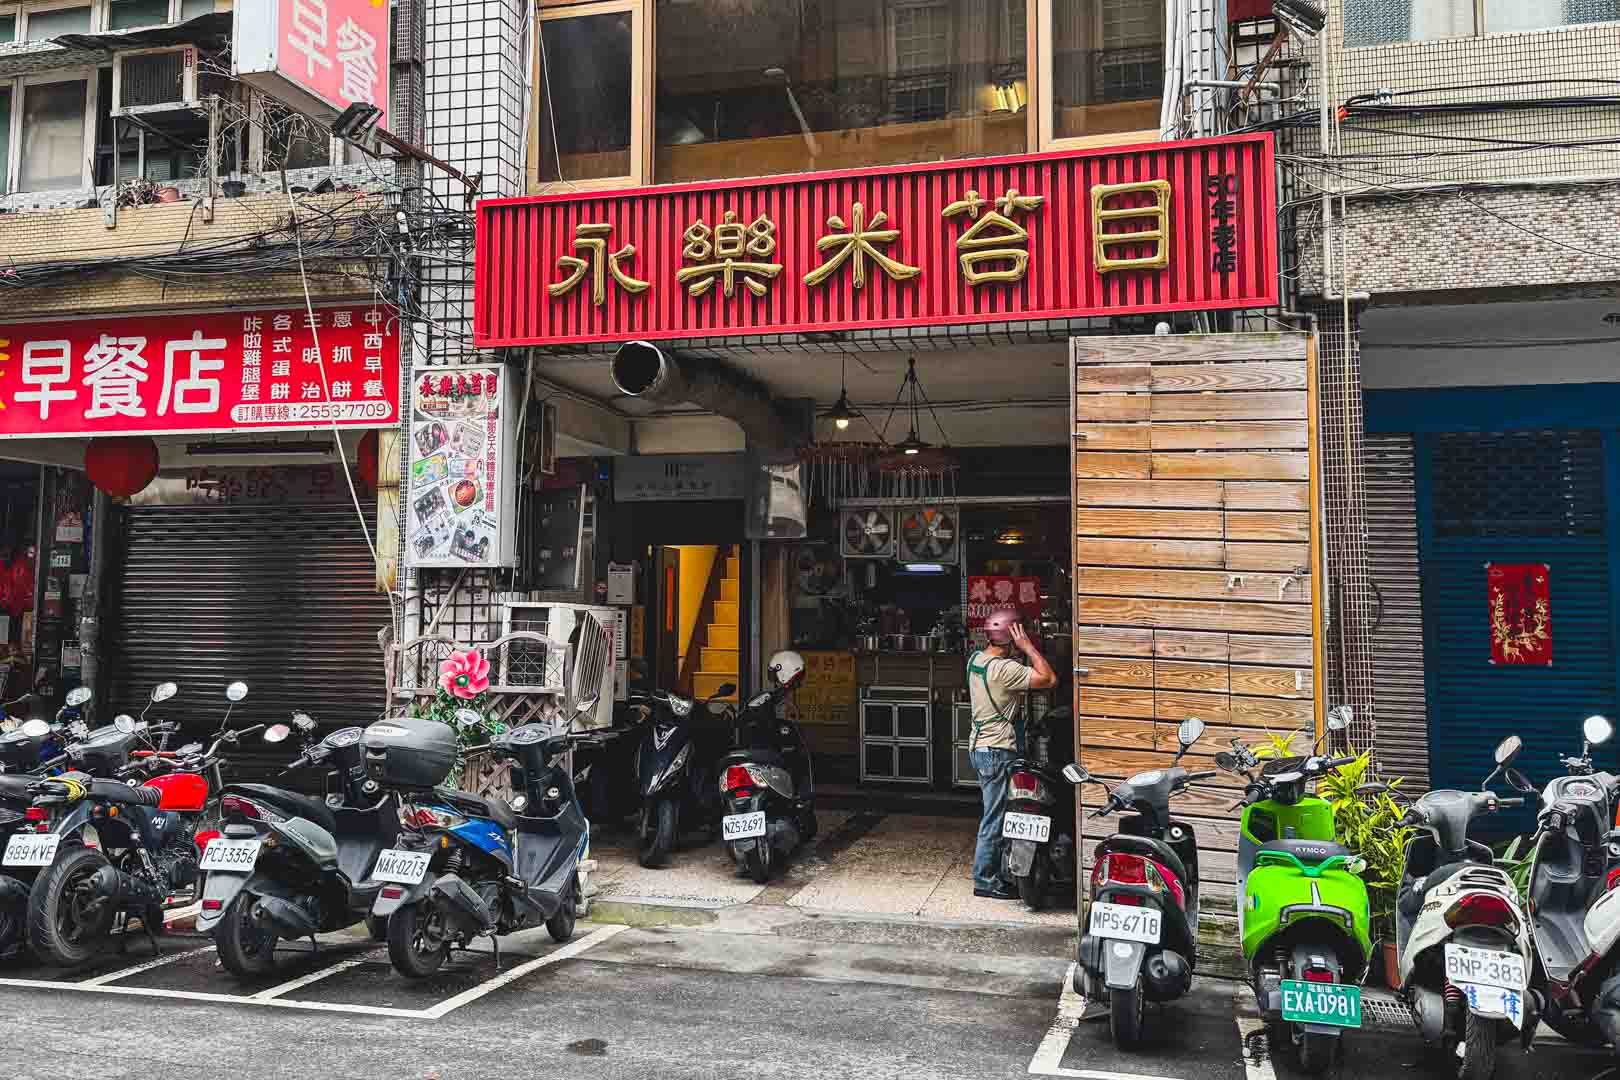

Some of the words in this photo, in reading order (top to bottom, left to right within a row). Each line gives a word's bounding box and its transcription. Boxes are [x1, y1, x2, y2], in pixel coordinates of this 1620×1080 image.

[547, 179, 1172, 307] 永樂米苔目
[14, 329, 227, 420] 早餐店
[240, 316, 263, 401] 咔啦雞腿堡
[270, 314, 292, 400] 各式蛋餅
[302, 313, 321, 399] 三明治
[363, 309, 383, 398] 中西早餐
[1093, 911, 1158, 935] MPS-6718
[1284, 990, 1355, 1017] EXA-0981
